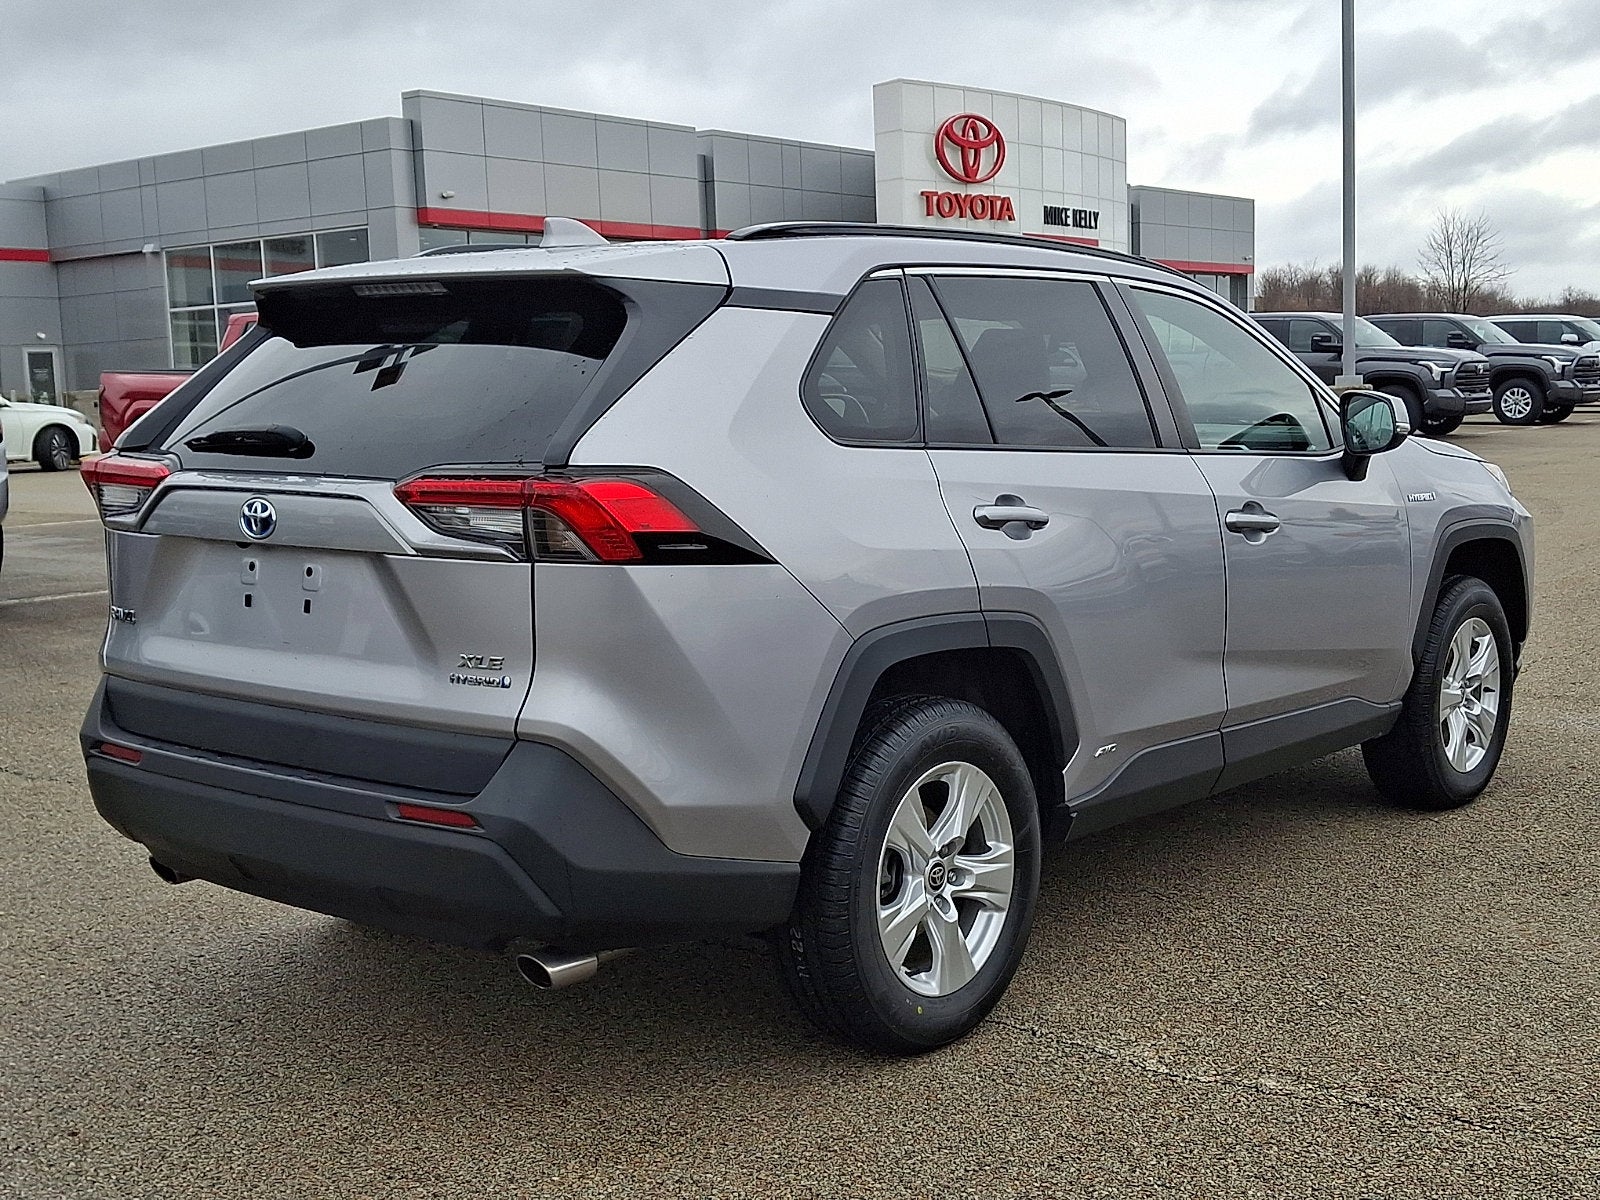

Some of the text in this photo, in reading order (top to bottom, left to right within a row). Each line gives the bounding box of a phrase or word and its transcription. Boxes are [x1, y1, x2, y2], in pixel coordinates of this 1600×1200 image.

[921, 191, 1016, 221] TOYOTA
[1043, 205, 1100, 230] MIKE KELLY
[458, 653, 505, 670] XLE
